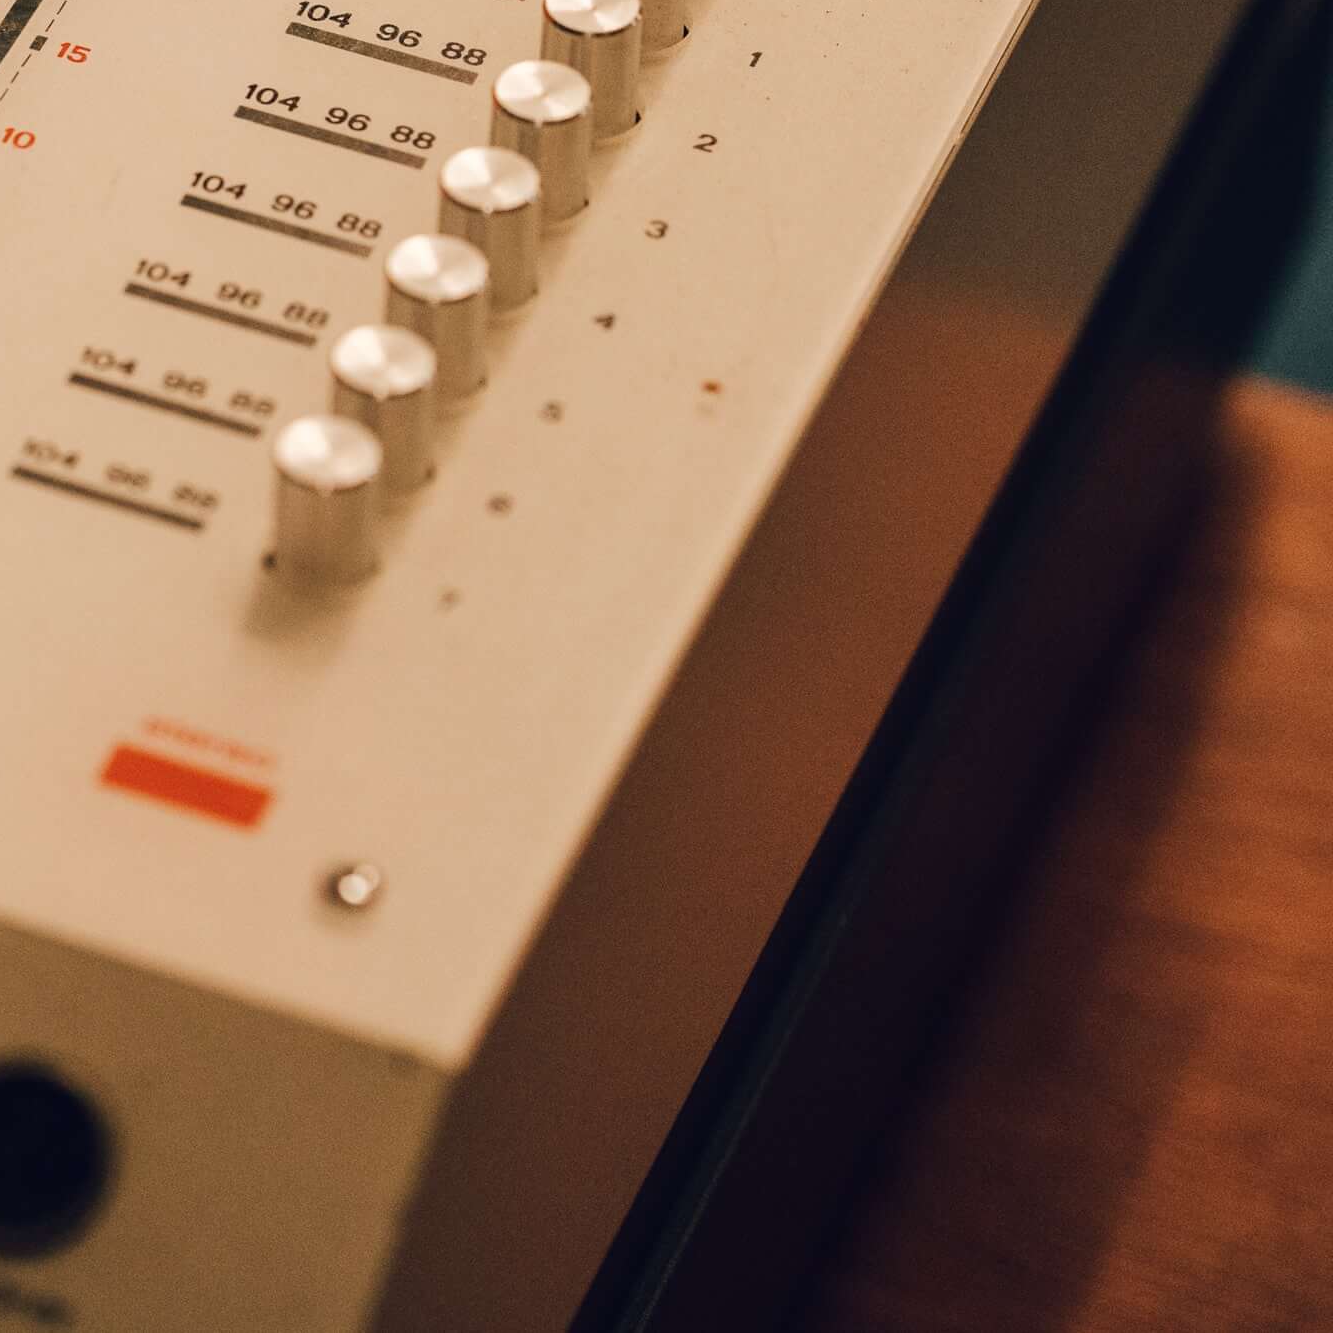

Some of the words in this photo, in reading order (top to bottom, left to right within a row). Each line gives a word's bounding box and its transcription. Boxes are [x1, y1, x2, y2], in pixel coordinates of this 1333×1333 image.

[296, 0, 353, 29] 104
[376, 22, 423, 49] 96
[441, 41, 488, 67] 88
[56, 41, 93, 65] 15
[748, 50, 764, 68] 1
[244, 83, 302, 113] 104
[325, 106, 372, 133] 96
[389, 124, 437, 150] 88
[0, 126, 37, 151] 10
[693, 133, 719, 153] 2
[190, 171, 248, 201] 104
[271, 193, 318, 220] 96
[336, 213, 383, 239] 88
[644, 219, 671, 240] 3
[136, 259, 193, 288] 104
[217, 281, 264, 309] 96
[283, 301, 331, 329] 88
[593, 311, 617, 331] 4
